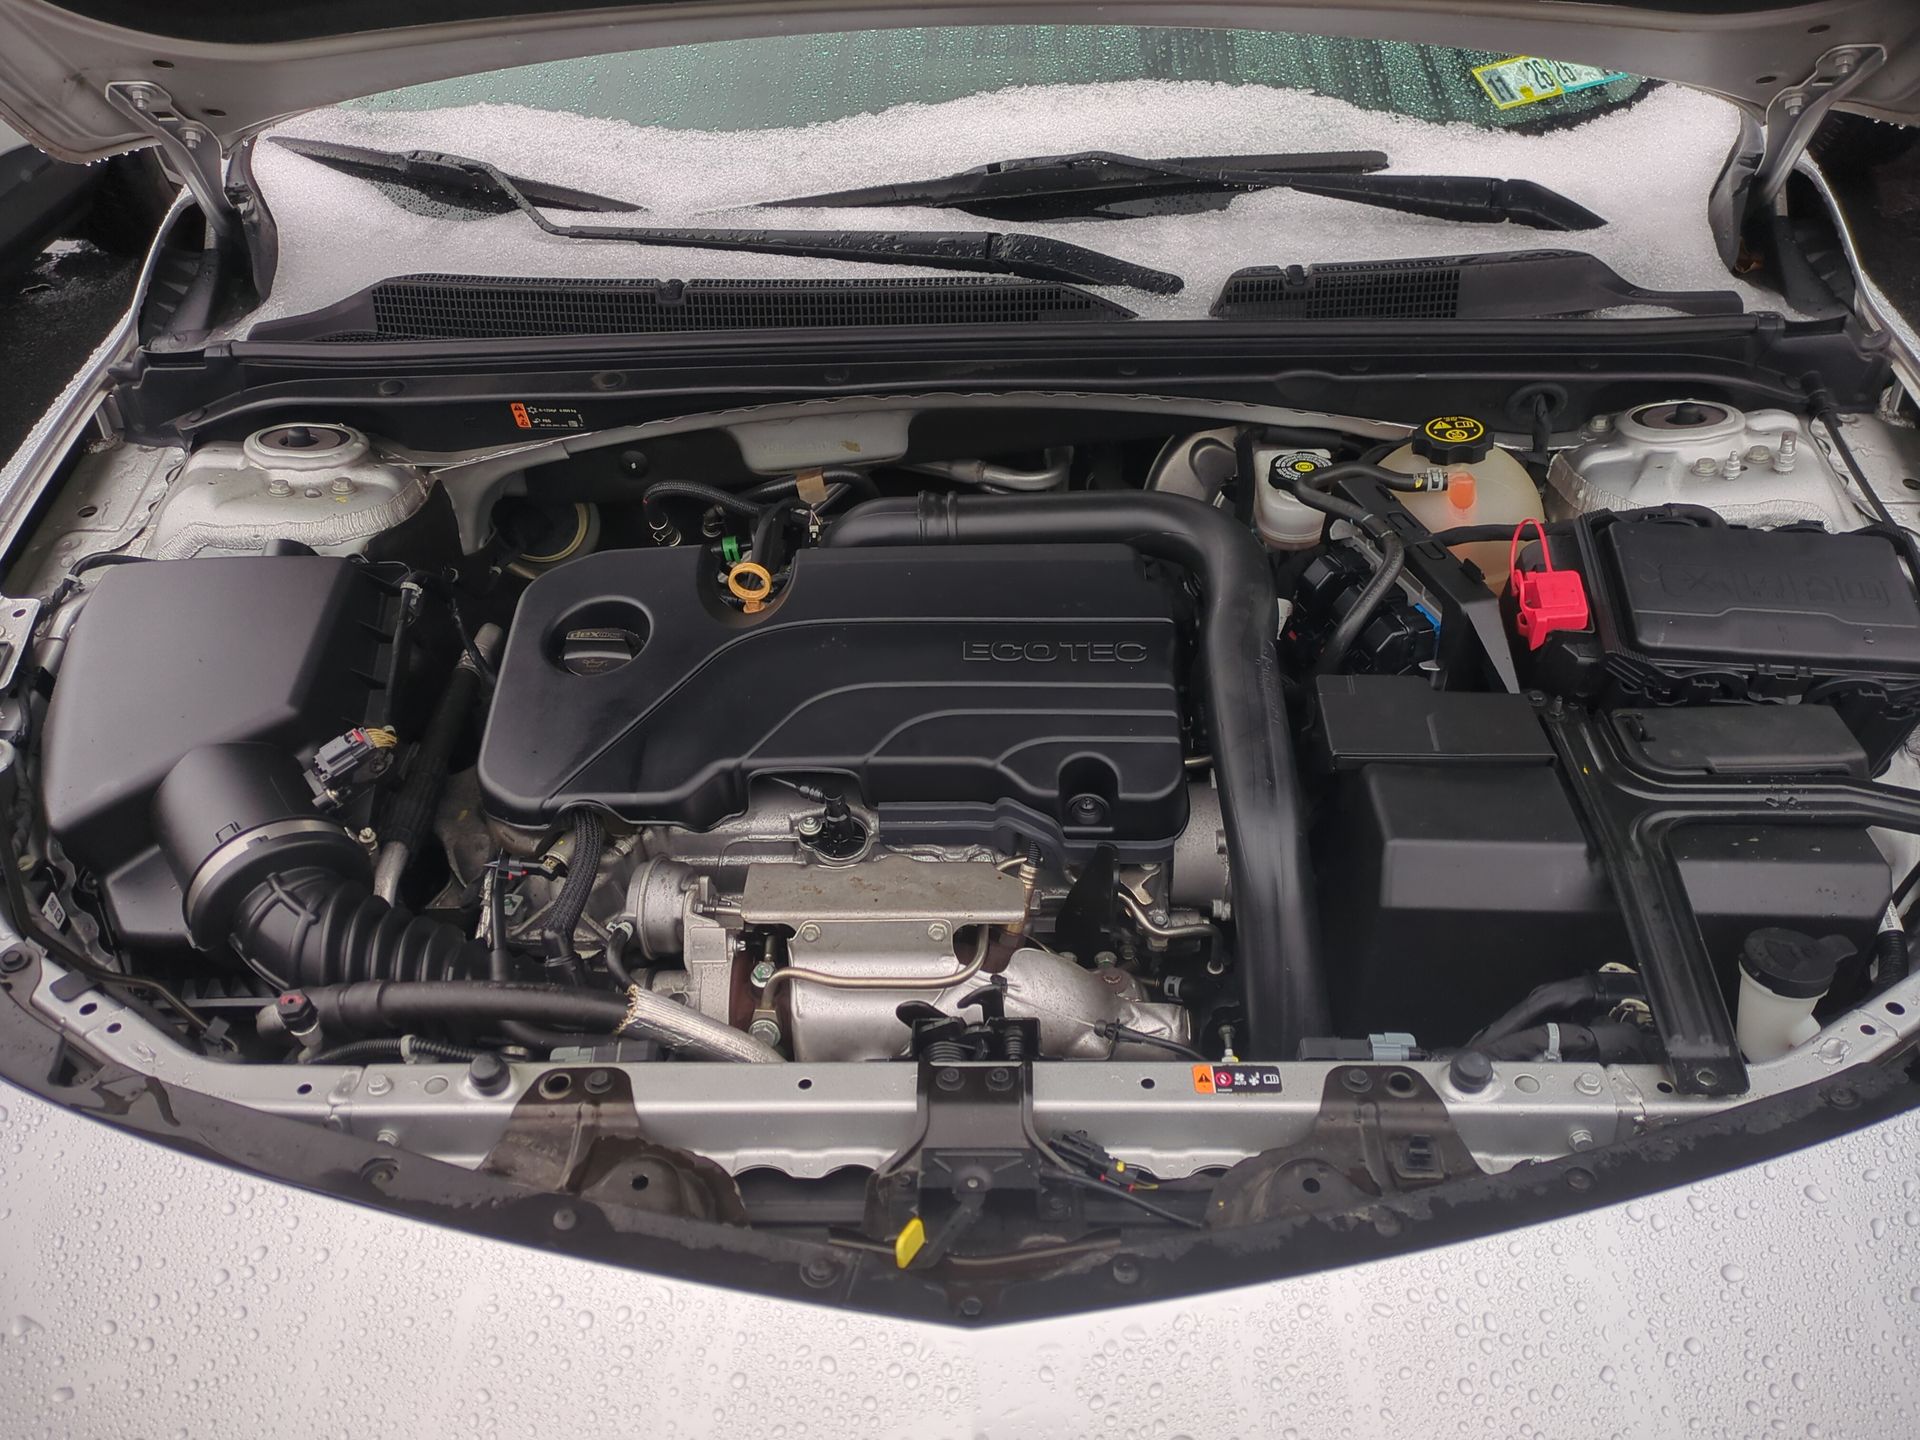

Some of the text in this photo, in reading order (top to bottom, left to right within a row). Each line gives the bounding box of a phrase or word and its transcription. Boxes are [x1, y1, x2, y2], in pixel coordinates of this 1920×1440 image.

[1486, 60, 1555, 101] 11 26
[1548, 60, 1577, 83] 26
[962, 640, 1148, 663] ECOTEC
